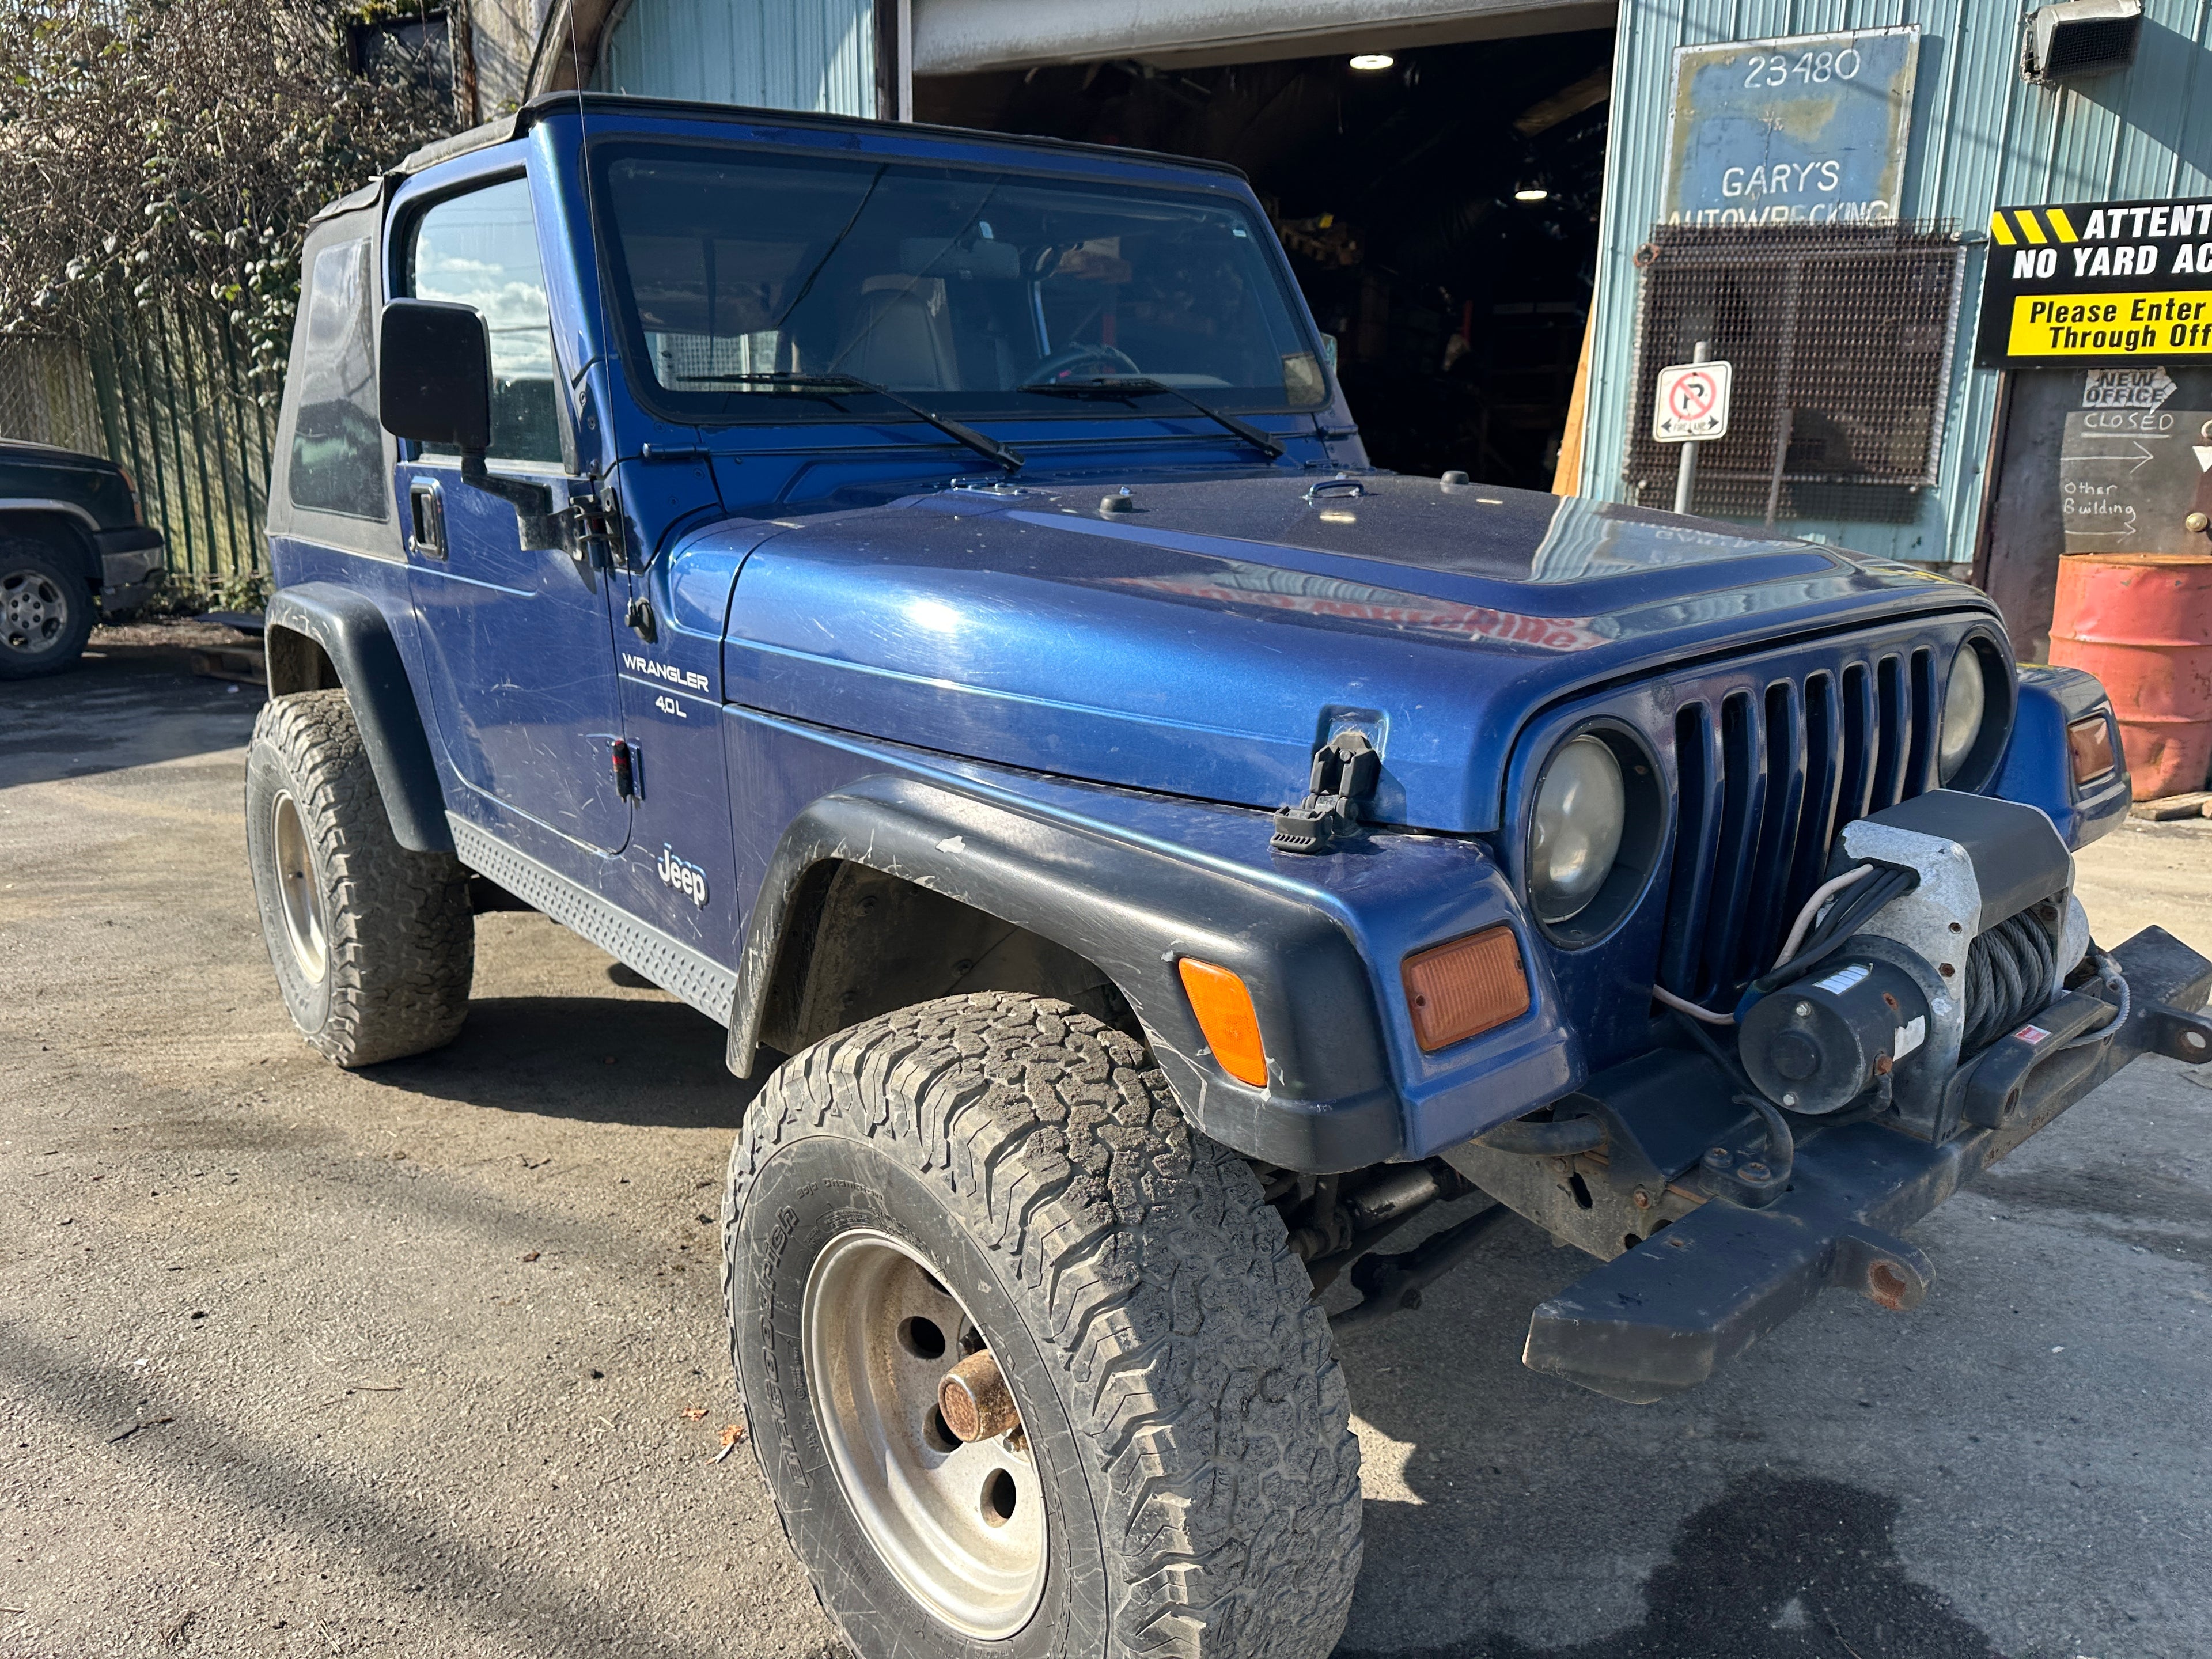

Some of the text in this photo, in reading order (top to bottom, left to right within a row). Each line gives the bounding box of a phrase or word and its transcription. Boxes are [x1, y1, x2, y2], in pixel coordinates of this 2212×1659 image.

[1744, 48, 1861, 88] 23480
[1722, 160, 1839, 196] GARY'S
[2082, 204, 2212, 240] ATTENT
[2012, 242, 2212, 279] NO YARD AC
[2030, 298, 2207, 323] Please Enter
[2049, 323, 2212, 351] Through Off
[2099, 373, 2154, 387] NEW
[2086, 388, 2165, 403] OFFICE
[2084, 411, 2174, 431] CLOSED
[2064, 482, 2118, 495] Other
[2063, 497, 2137, 524] Building
[622, 652, 709, 692] WRANGLER
[657, 843, 708, 906] Jeep
